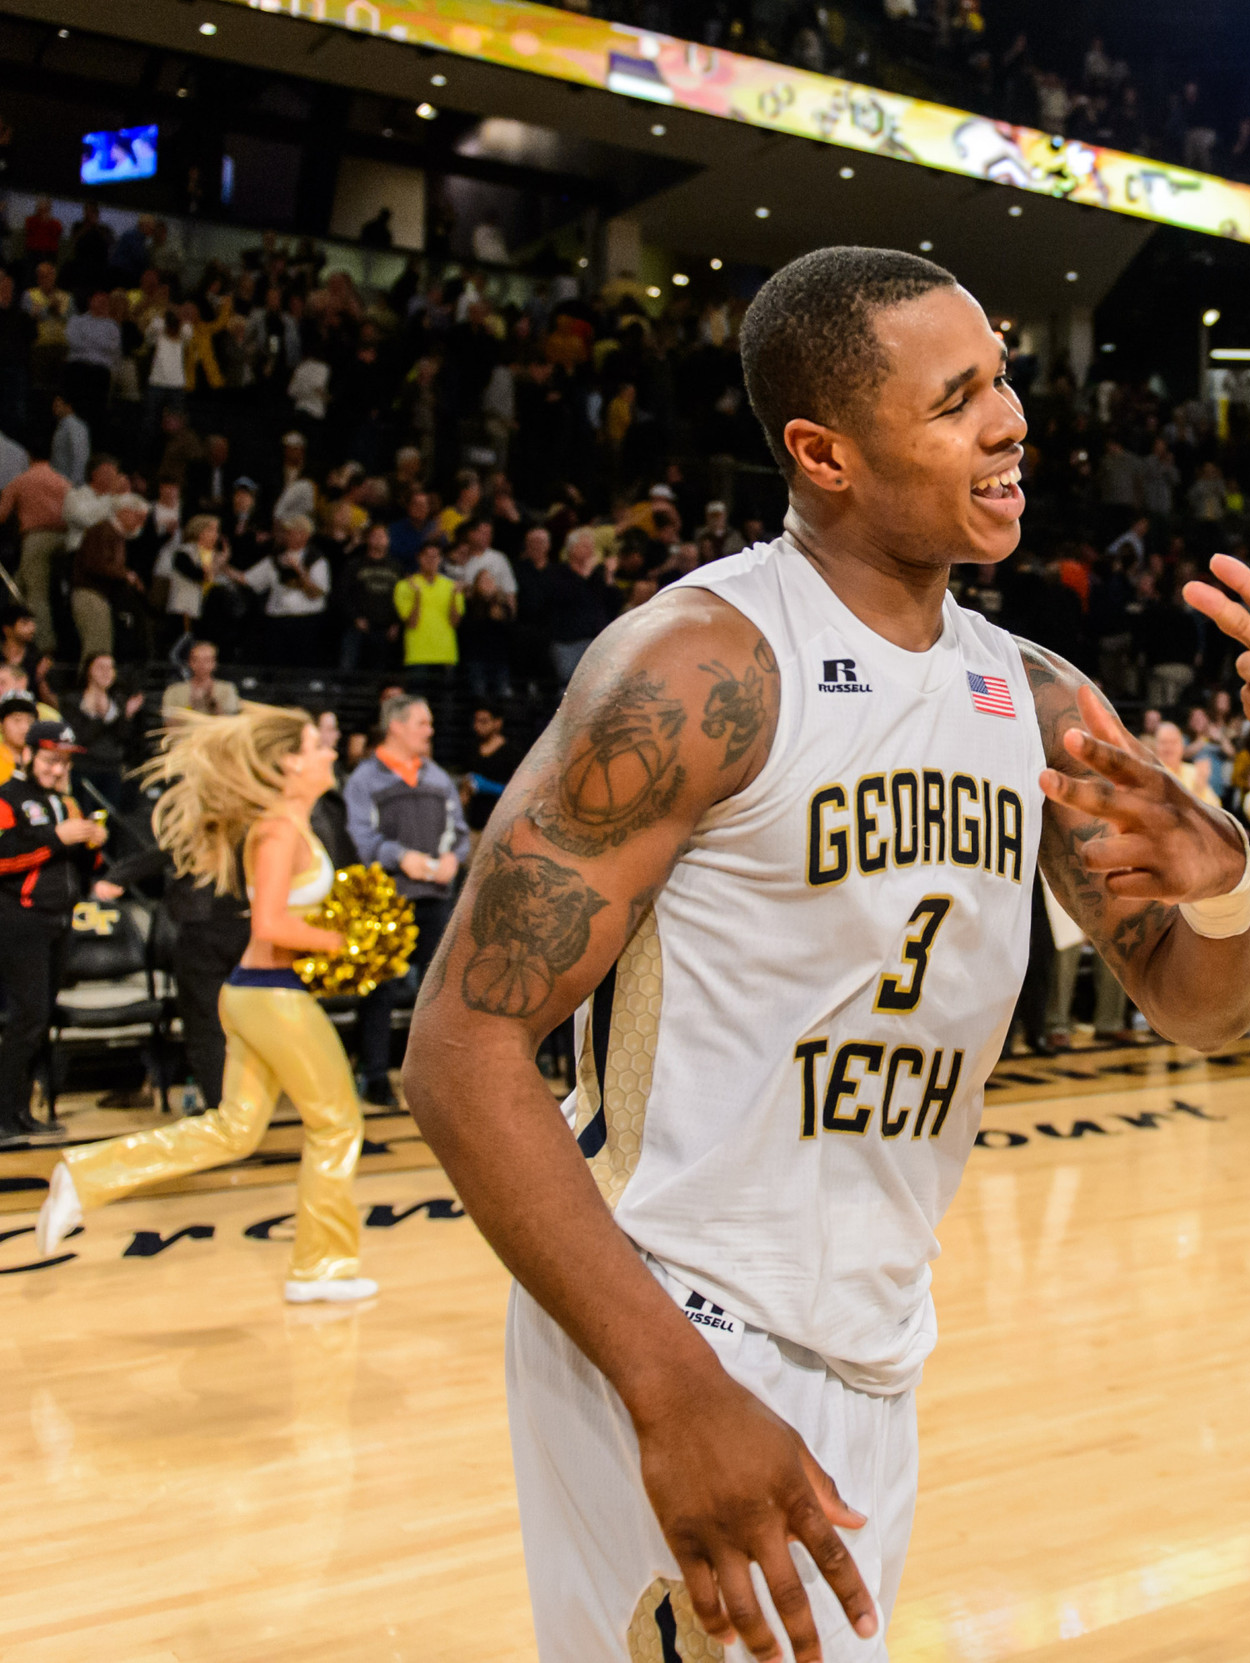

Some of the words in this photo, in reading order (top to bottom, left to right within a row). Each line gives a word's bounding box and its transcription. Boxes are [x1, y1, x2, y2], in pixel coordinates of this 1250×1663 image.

[818, 684, 873, 693] RUSSELL
[823, 658, 857, 682] R
[807, 768, 1024, 888] GEORGIA
[872, 894, 953, 1014] 3
[794, 1037, 964, 1141] TECH
[681, 1309, 734, 1333] USSELL
